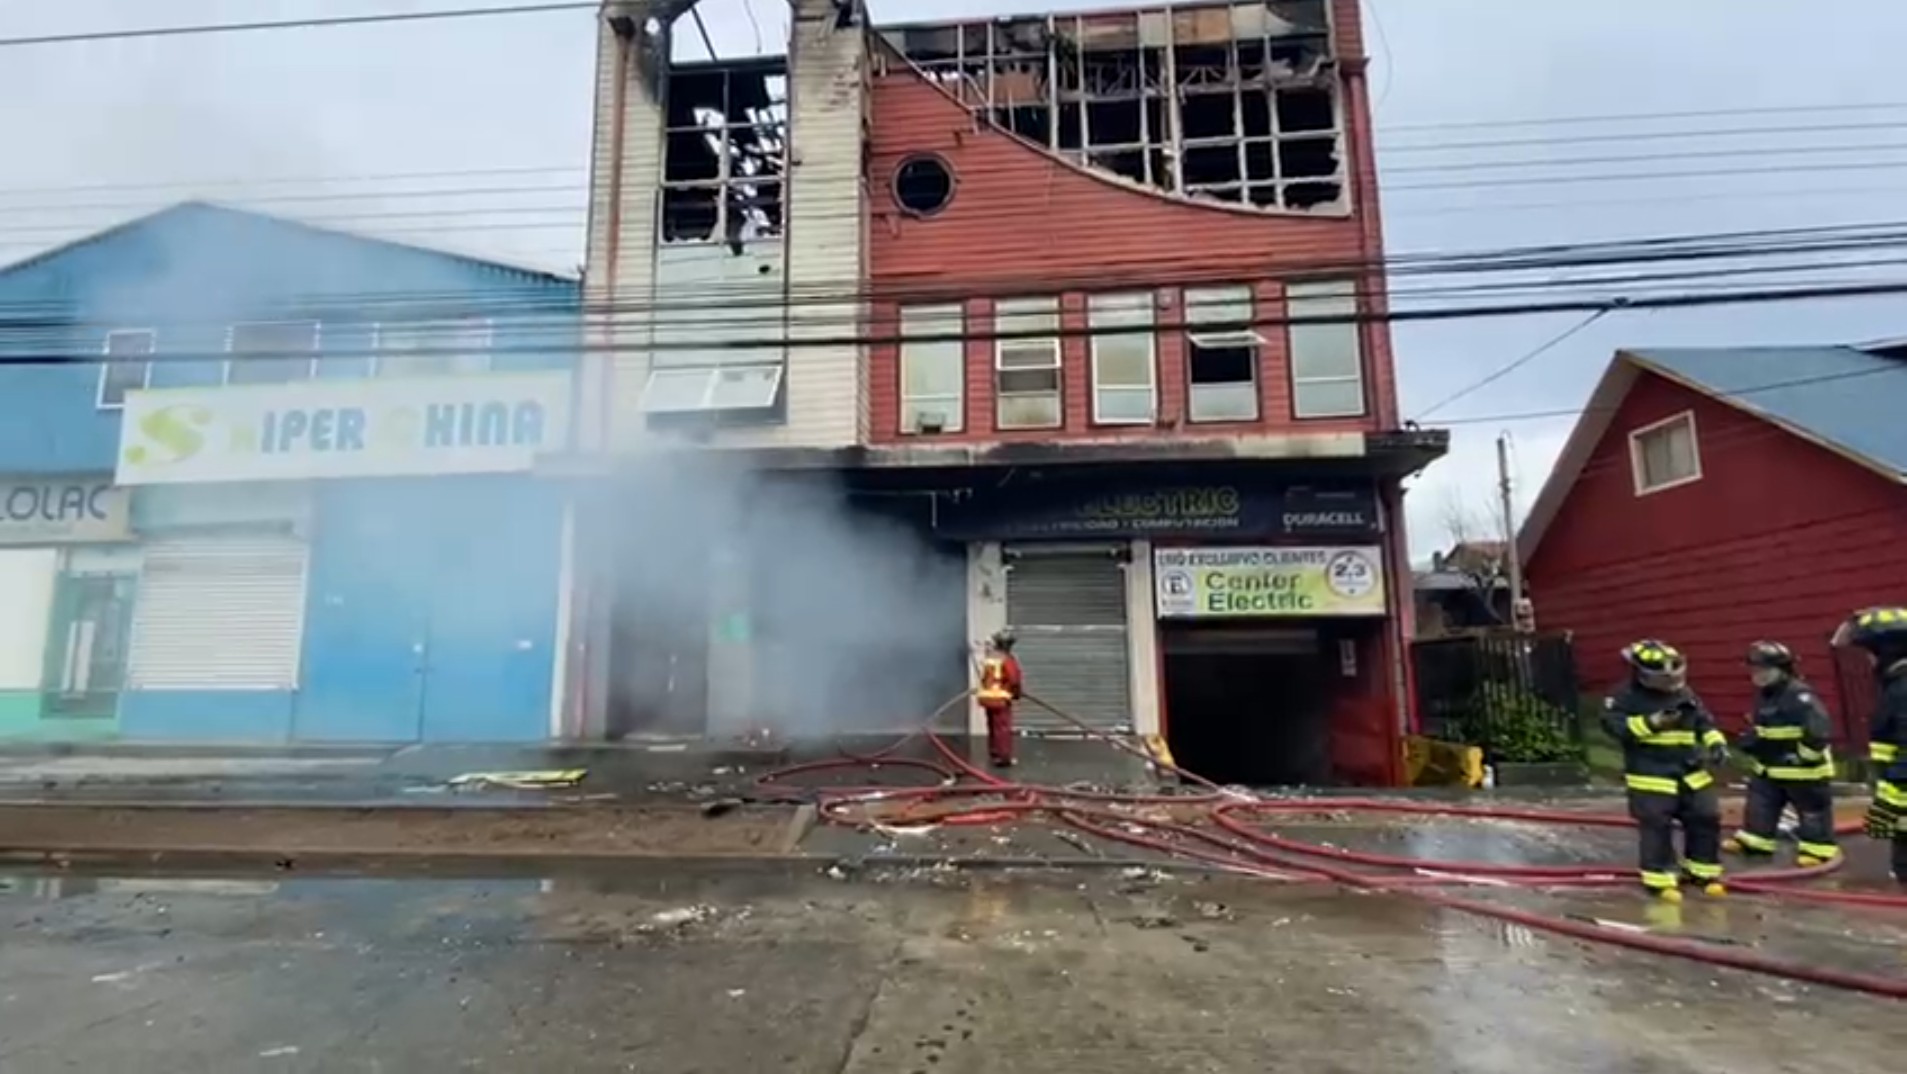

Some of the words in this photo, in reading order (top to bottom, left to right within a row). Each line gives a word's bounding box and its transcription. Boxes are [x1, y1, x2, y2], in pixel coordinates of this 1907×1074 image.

[0, 485, 110, 521] OLAC
[1283, 511, 1364, 526] DURACELL
[1205, 571, 1300, 591] Center
[1208, 591, 1314, 612] Electric
